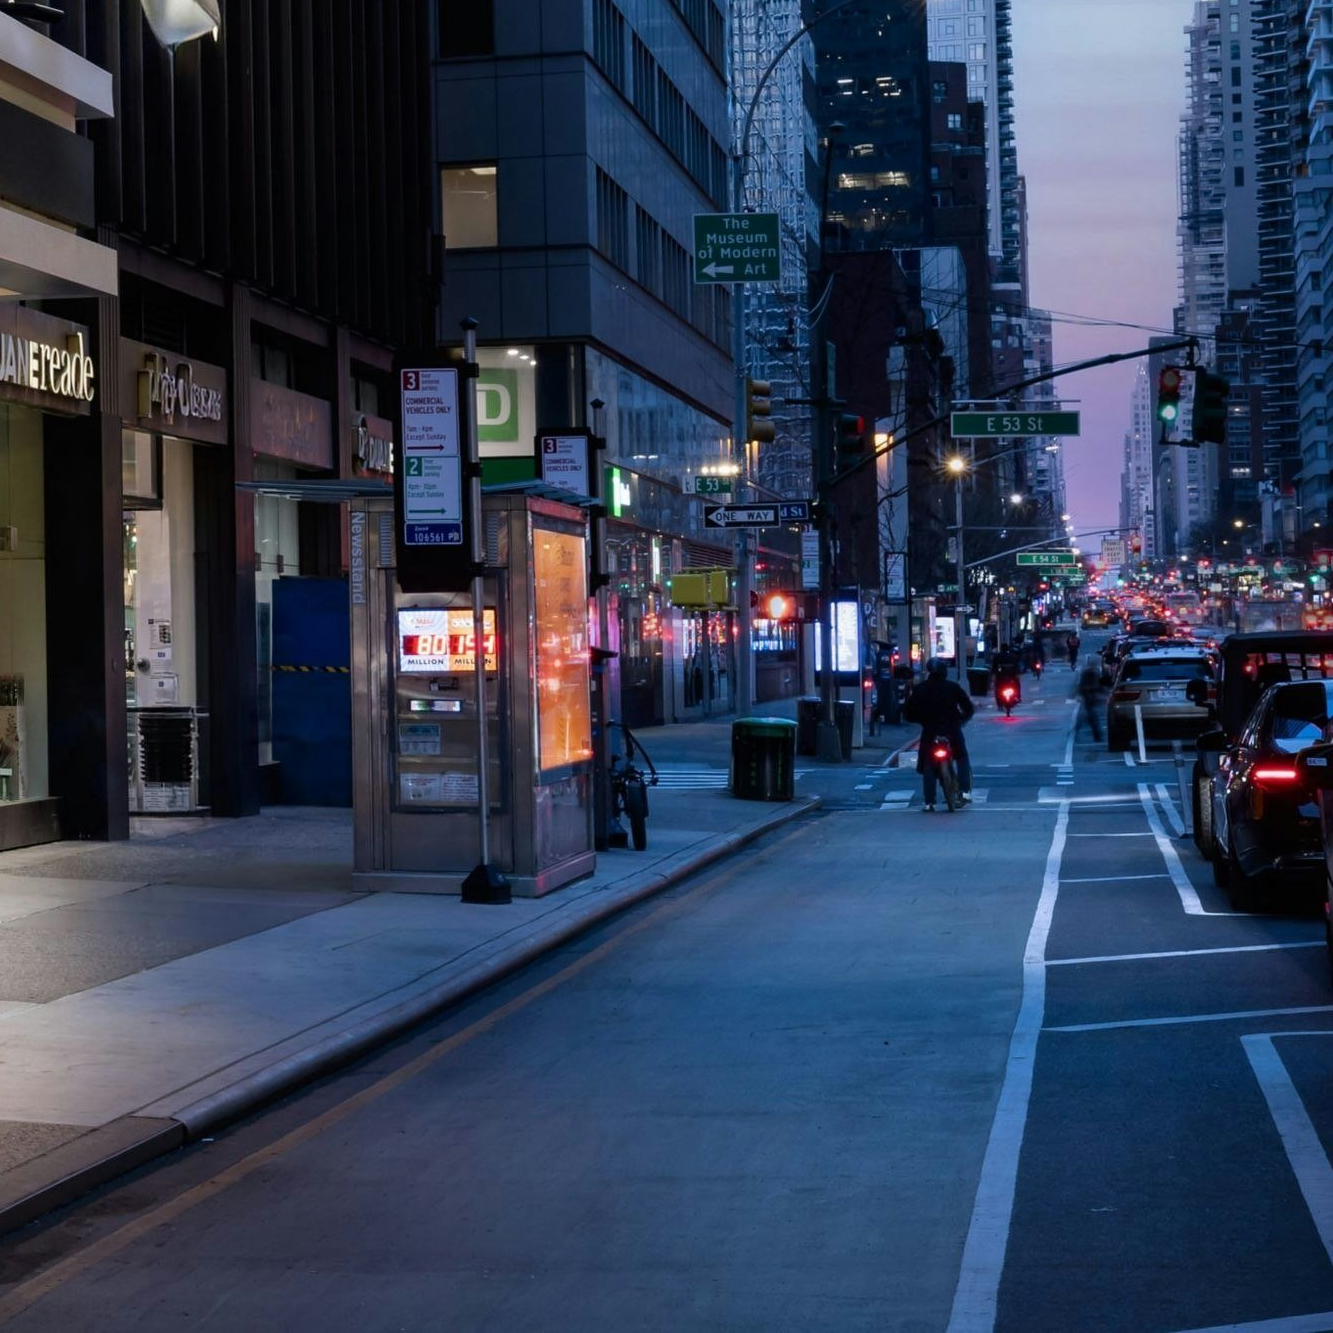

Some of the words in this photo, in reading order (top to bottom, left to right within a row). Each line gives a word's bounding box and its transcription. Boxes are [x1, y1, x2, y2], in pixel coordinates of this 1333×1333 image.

[722, 217, 750, 229] The
[706, 233, 768, 244] Museum
[698, 246, 713, 259] of
[721, 247, 776, 259] Modern
[744, 263, 767, 275] Art
[406, 372, 416, 389] 3
[405, 397, 444, 405] COMMERCIAL
[406, 406, 435, 414] VEHICLES
[436, 406, 451, 414] ONLY
[986, 417, 995, 432] E
[1002, 417, 1021, 432] 53
[1027, 417, 1043, 432] St
[546, 439, 554, 453] 3
[410, 458, 418, 475] 2
[696, 478, 702, 491] E
[707, 477, 719, 491] 53
[715, 512, 736, 521] ONE
[747, 511, 770, 521] WAY
[790, 507, 803, 517] St
[414, 532, 444, 542] 106561
[351, 511, 366, 603] Newsstand
[1032, 555, 1037, 563] E
[1039, 555, 1049, 563] 54
[1050, 555, 1059, 563] St
[418, 635, 447, 655] 80
